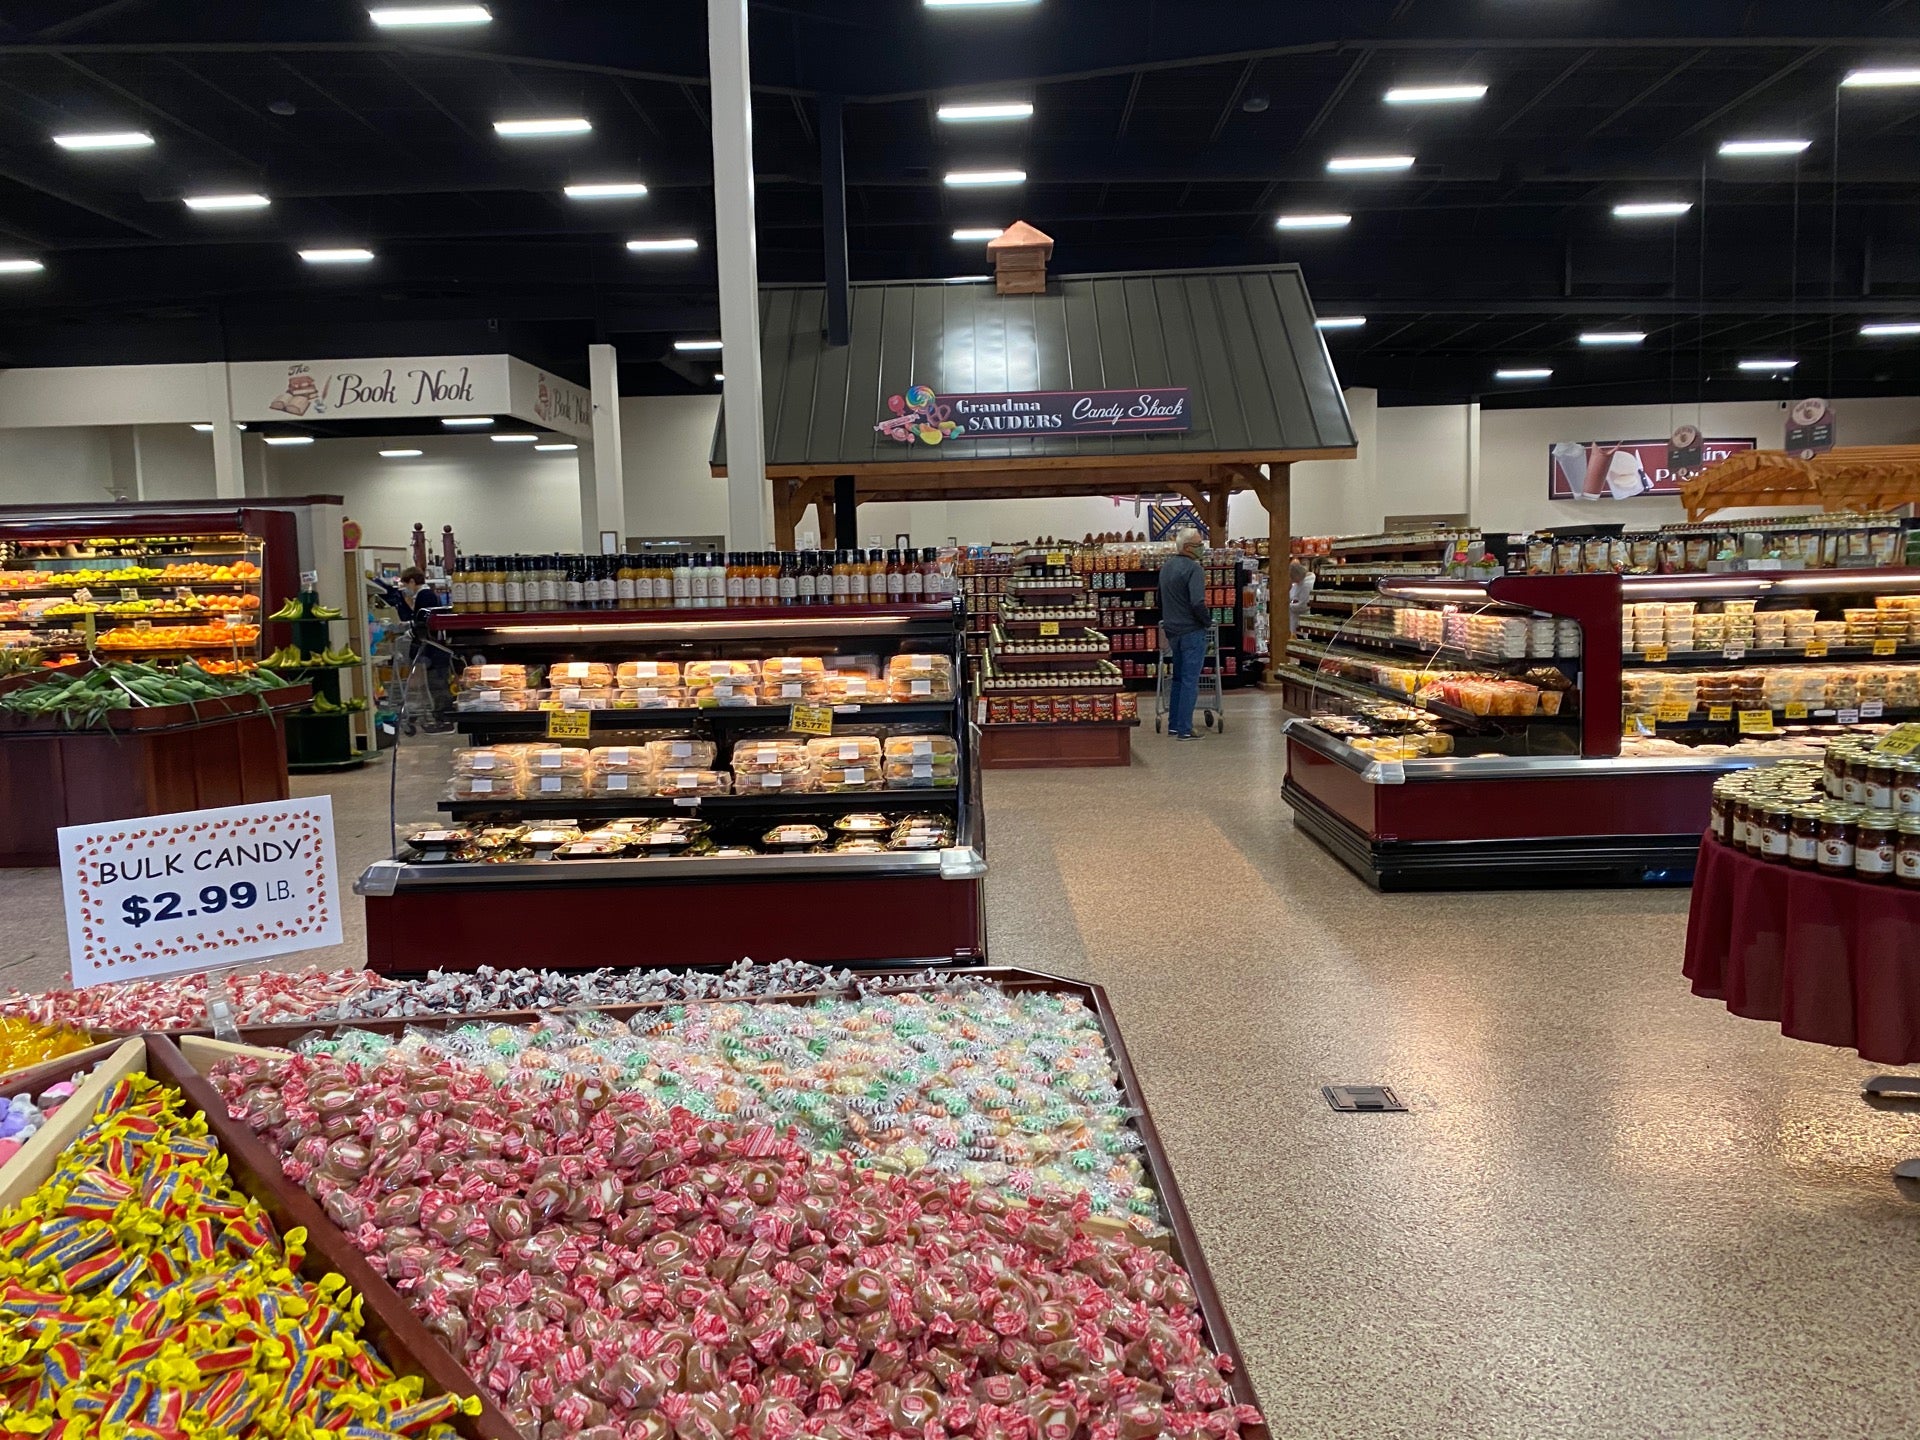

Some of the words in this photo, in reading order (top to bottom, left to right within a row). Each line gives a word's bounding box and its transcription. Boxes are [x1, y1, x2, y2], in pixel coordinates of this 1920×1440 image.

[288, 363, 310, 376] The
[334, 369, 398, 408] Book
[408, 367, 474, 404] Nook
[955, 399, 1041, 414] Grandma
[1072, 398, 1124, 424] Candy
[1128, 394, 1183, 417] Shack
[968, 413, 1063, 431] SAUDERS
[552, 726, 580, 734] $5.77
[795, 720, 822, 729] $5.77
[99, 853, 185, 885] BULK
[193, 838, 302, 870] CANDY
[122, 881, 258, 928] $2.99
[266, 880, 296, 902] LB.
